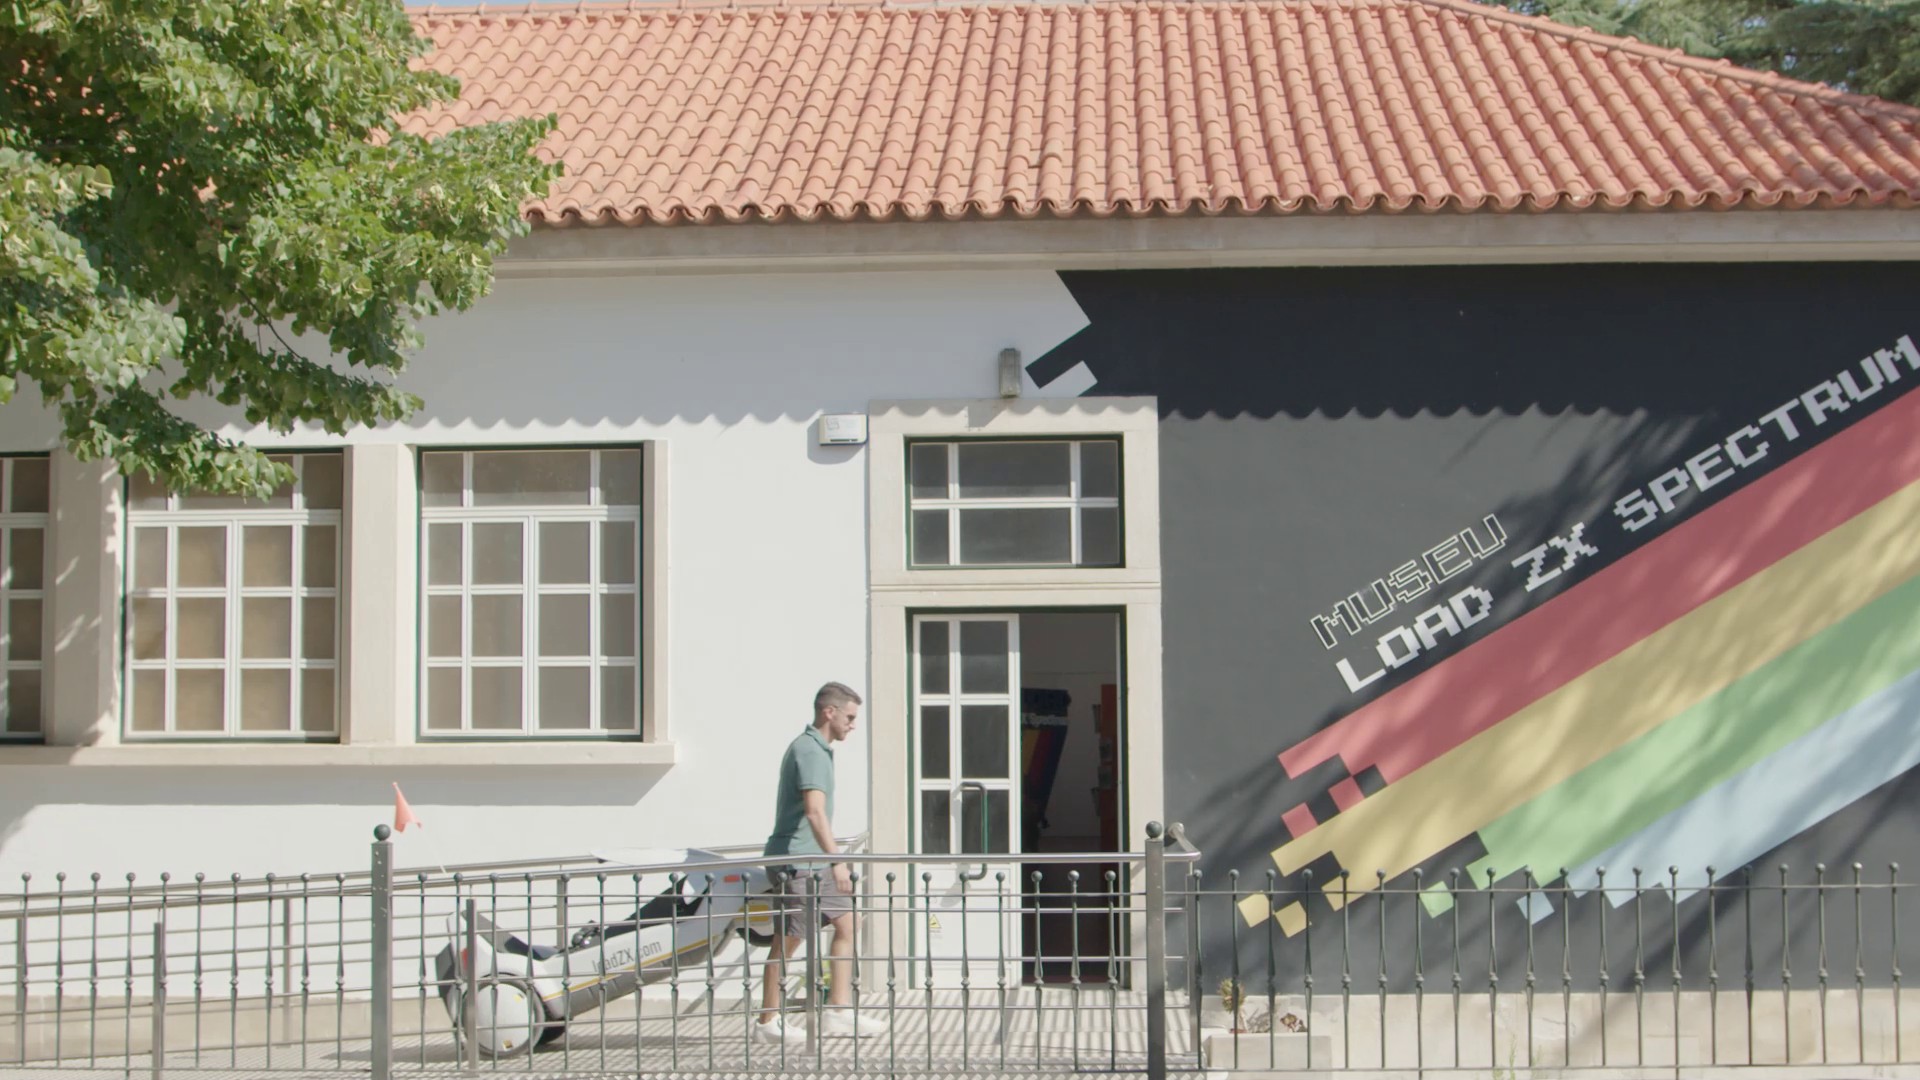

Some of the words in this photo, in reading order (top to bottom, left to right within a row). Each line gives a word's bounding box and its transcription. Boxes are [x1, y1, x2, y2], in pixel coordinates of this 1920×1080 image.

[1310, 513, 1508, 650] MUSEU
[1334, 584, 1493, 694] LOAD
[1511, 521, 1598, 593] ZX
[1613, 334, 1920, 532] SPECTRUM
[593, 941, 662, 973] ladZXcom
